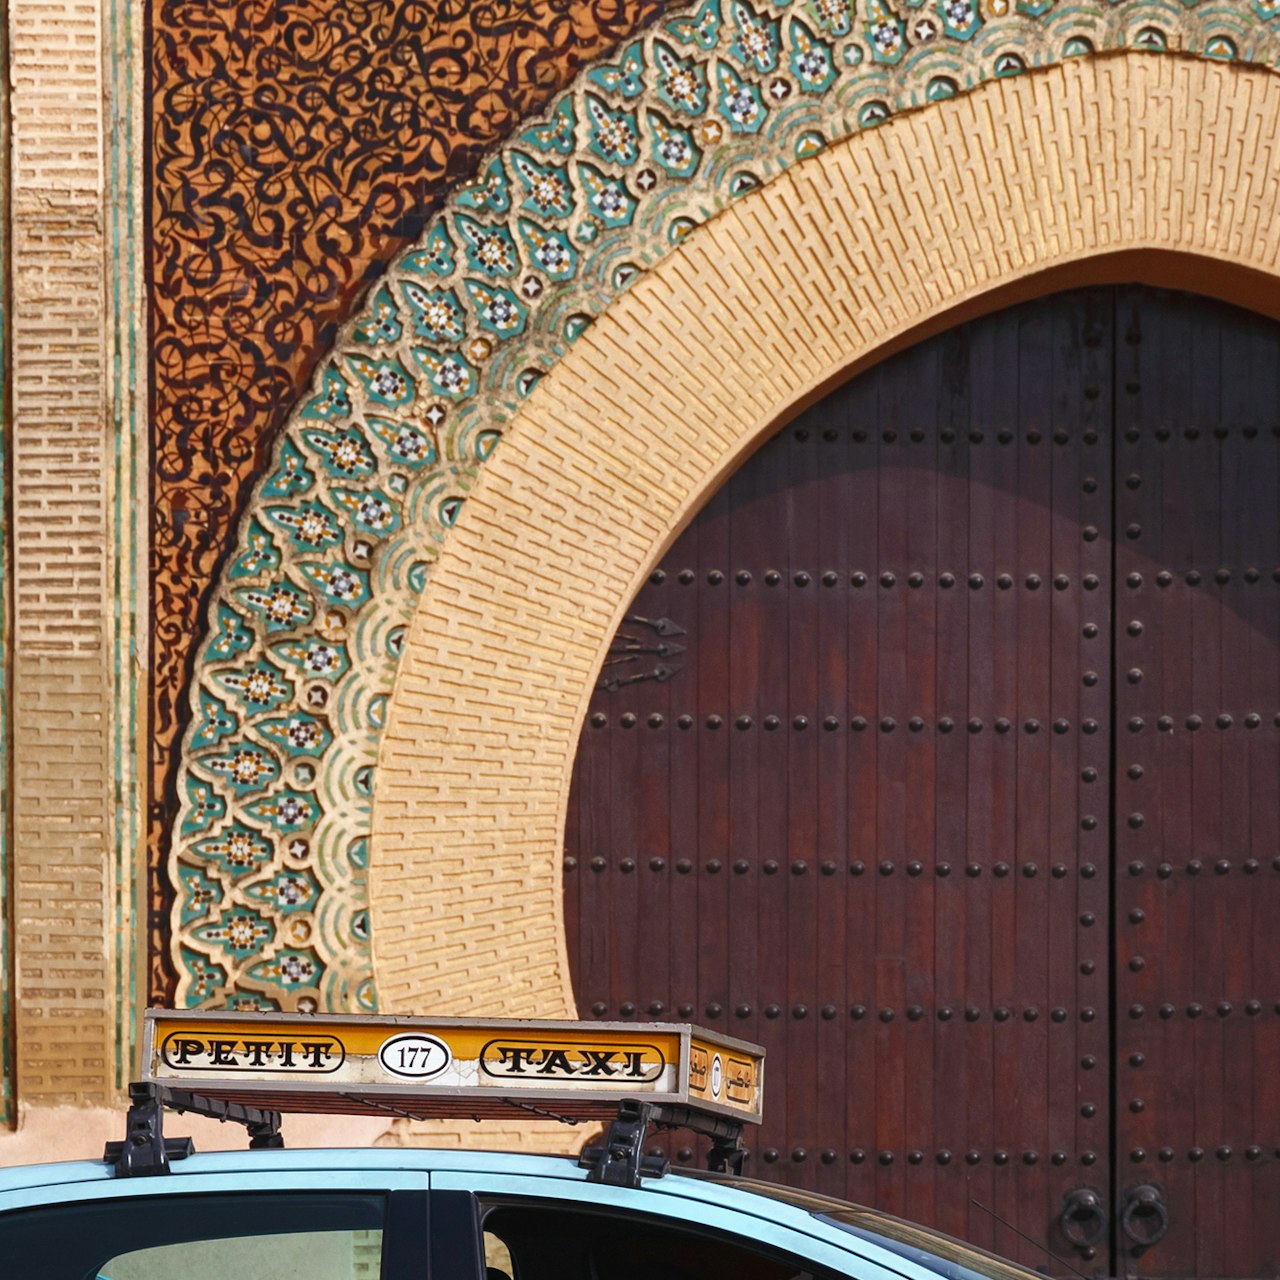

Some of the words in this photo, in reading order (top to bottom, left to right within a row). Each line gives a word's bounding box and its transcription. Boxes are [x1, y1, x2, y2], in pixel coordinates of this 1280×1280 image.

[173, 1039, 334, 1068] PETIT
[397, 1047, 432, 1069] 177
[497, 1047, 648, 1077] TAXI
